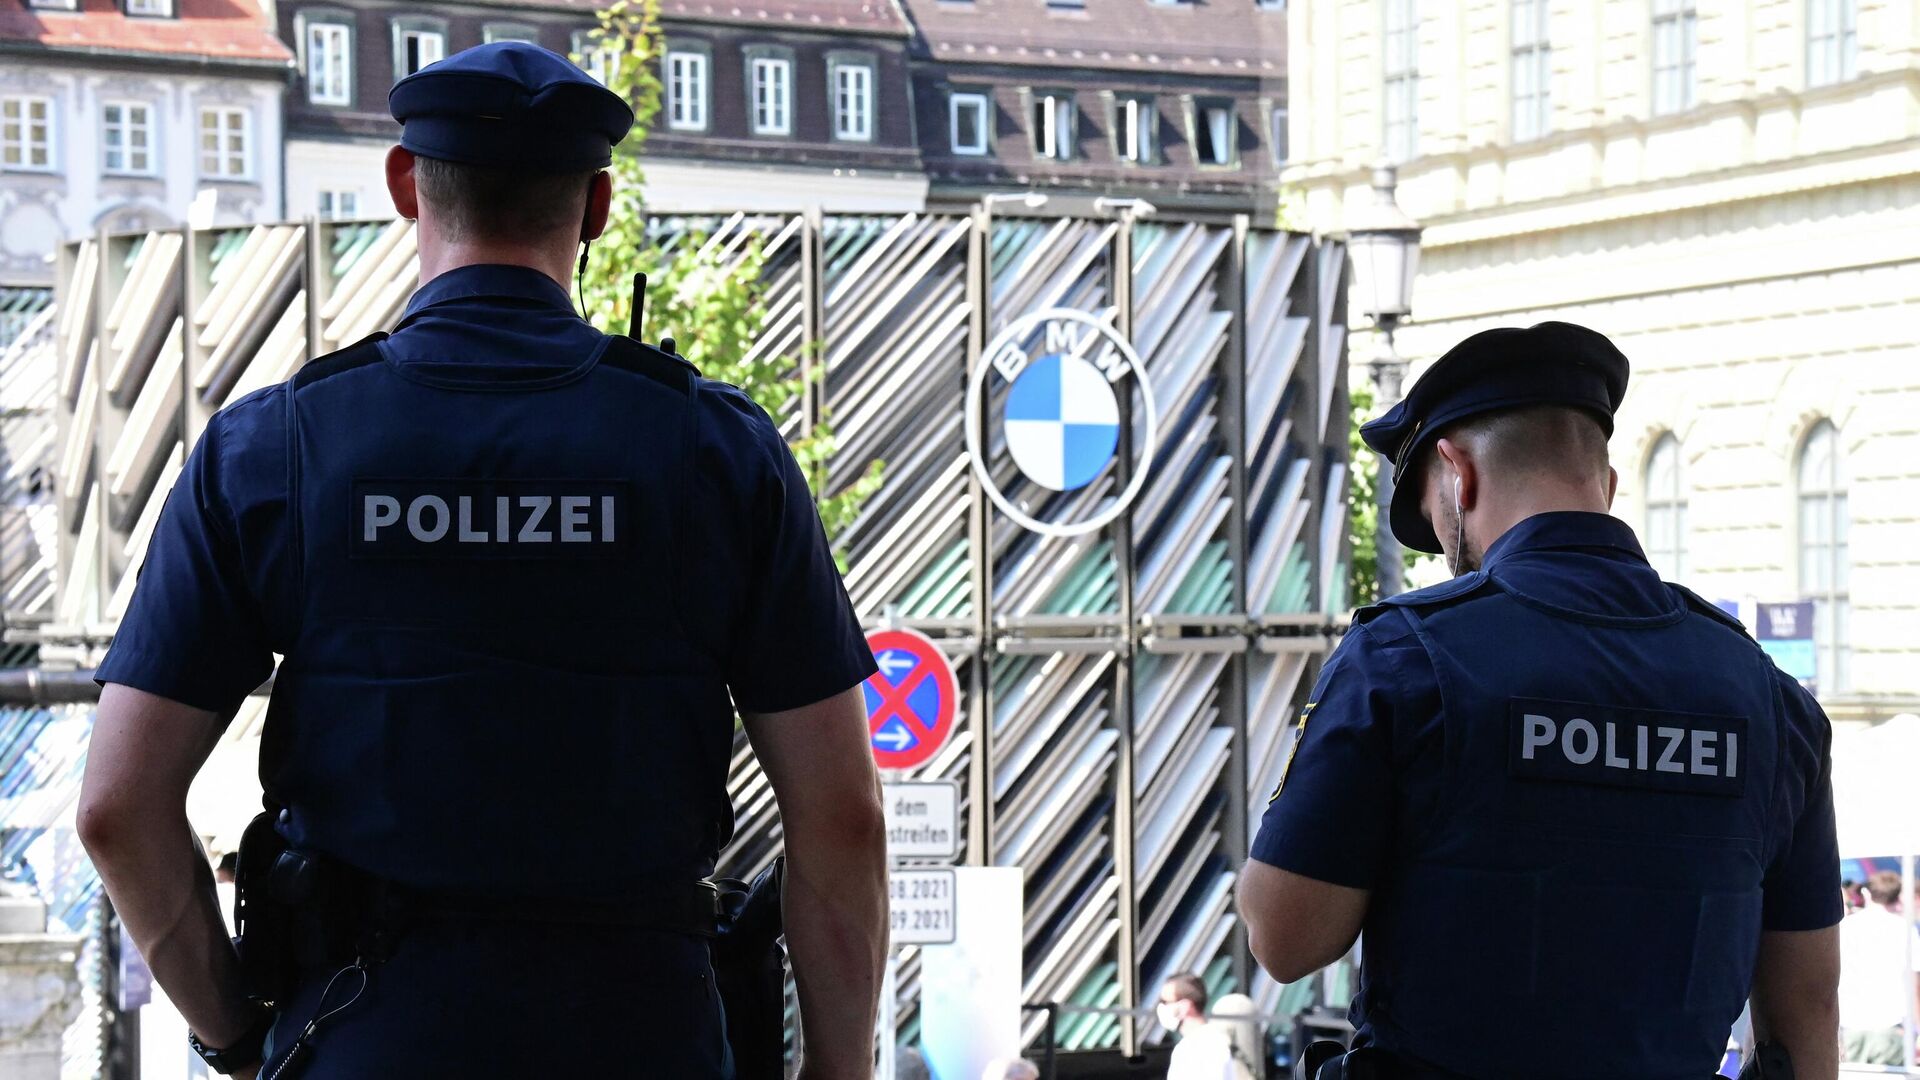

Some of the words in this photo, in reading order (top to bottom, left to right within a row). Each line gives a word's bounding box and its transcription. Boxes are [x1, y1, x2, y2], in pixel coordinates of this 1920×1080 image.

[993, 320, 1131, 383] BMW
[363, 494, 615, 543] POLIZEI
[1521, 713, 1738, 778] POLIZEI
[894, 797, 928, 816] dem
[889, 879, 948, 899] 08.2021
[890, 910, 950, 930] 09.2021
